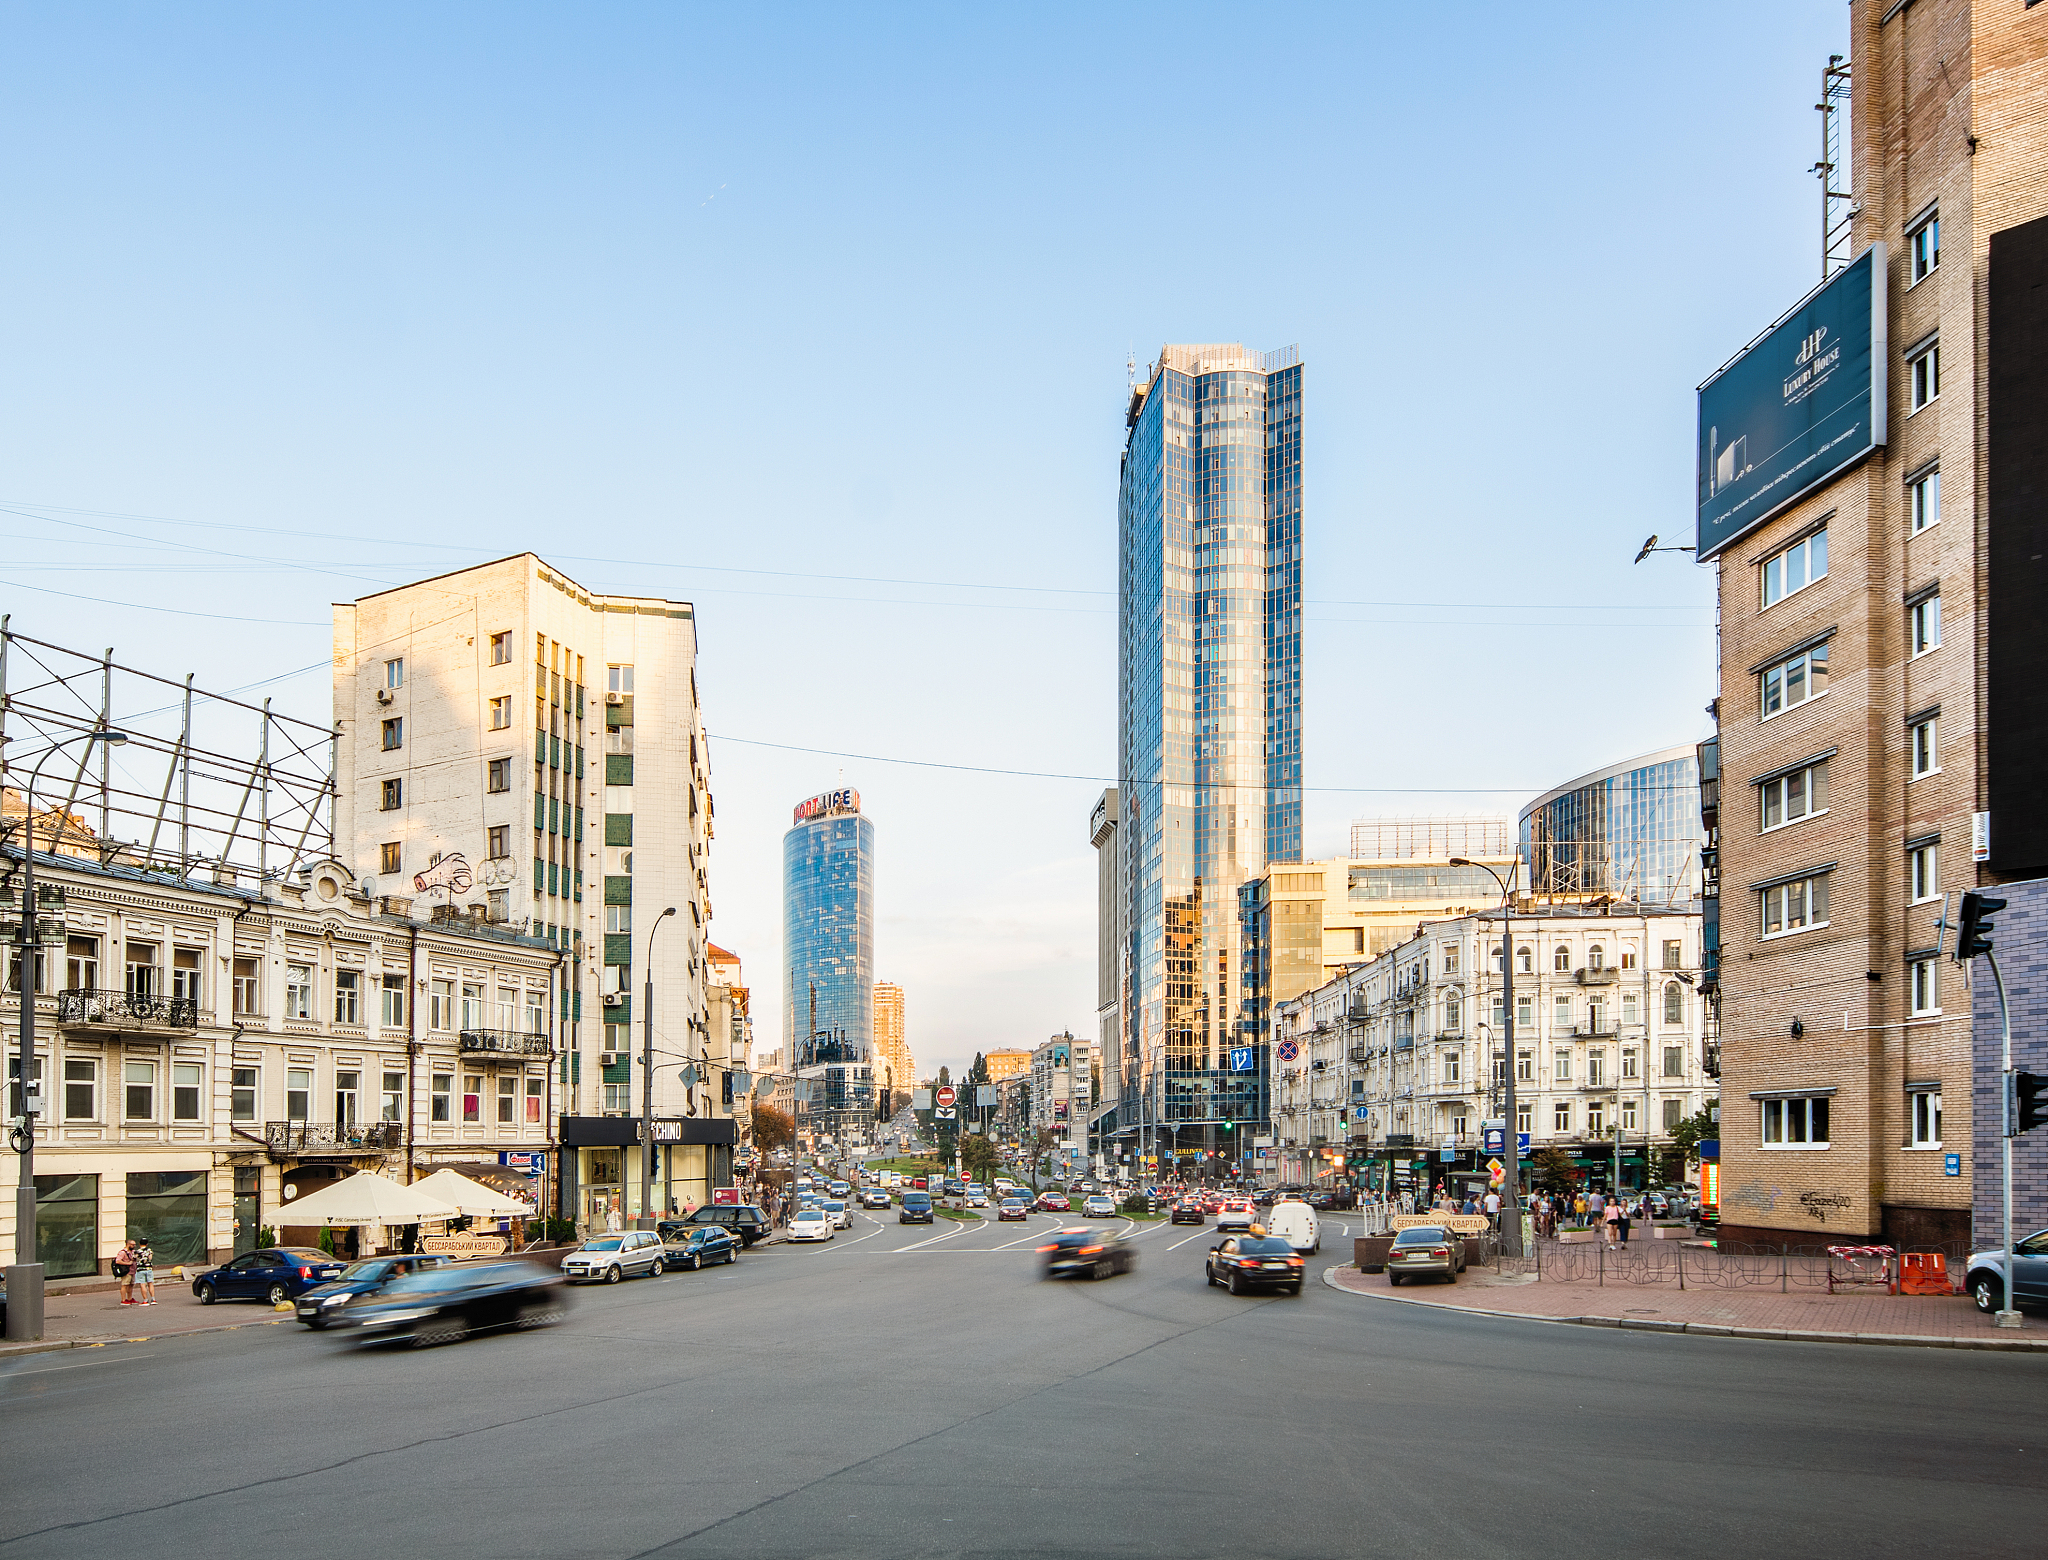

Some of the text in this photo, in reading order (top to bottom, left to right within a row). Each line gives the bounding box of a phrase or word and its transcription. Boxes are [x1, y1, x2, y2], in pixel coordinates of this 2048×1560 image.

[1813, 346, 1840, 376] HOUSE
[794, 797, 818, 824] PORT
[1175, 1148, 1203, 1156] GULLIVER
[1452, 1219, 1483, 1229] КВАРТАЛ
[427, 1241, 501, 1251] БЕССАРАБСЬКИЙ КВАРТАЛ
